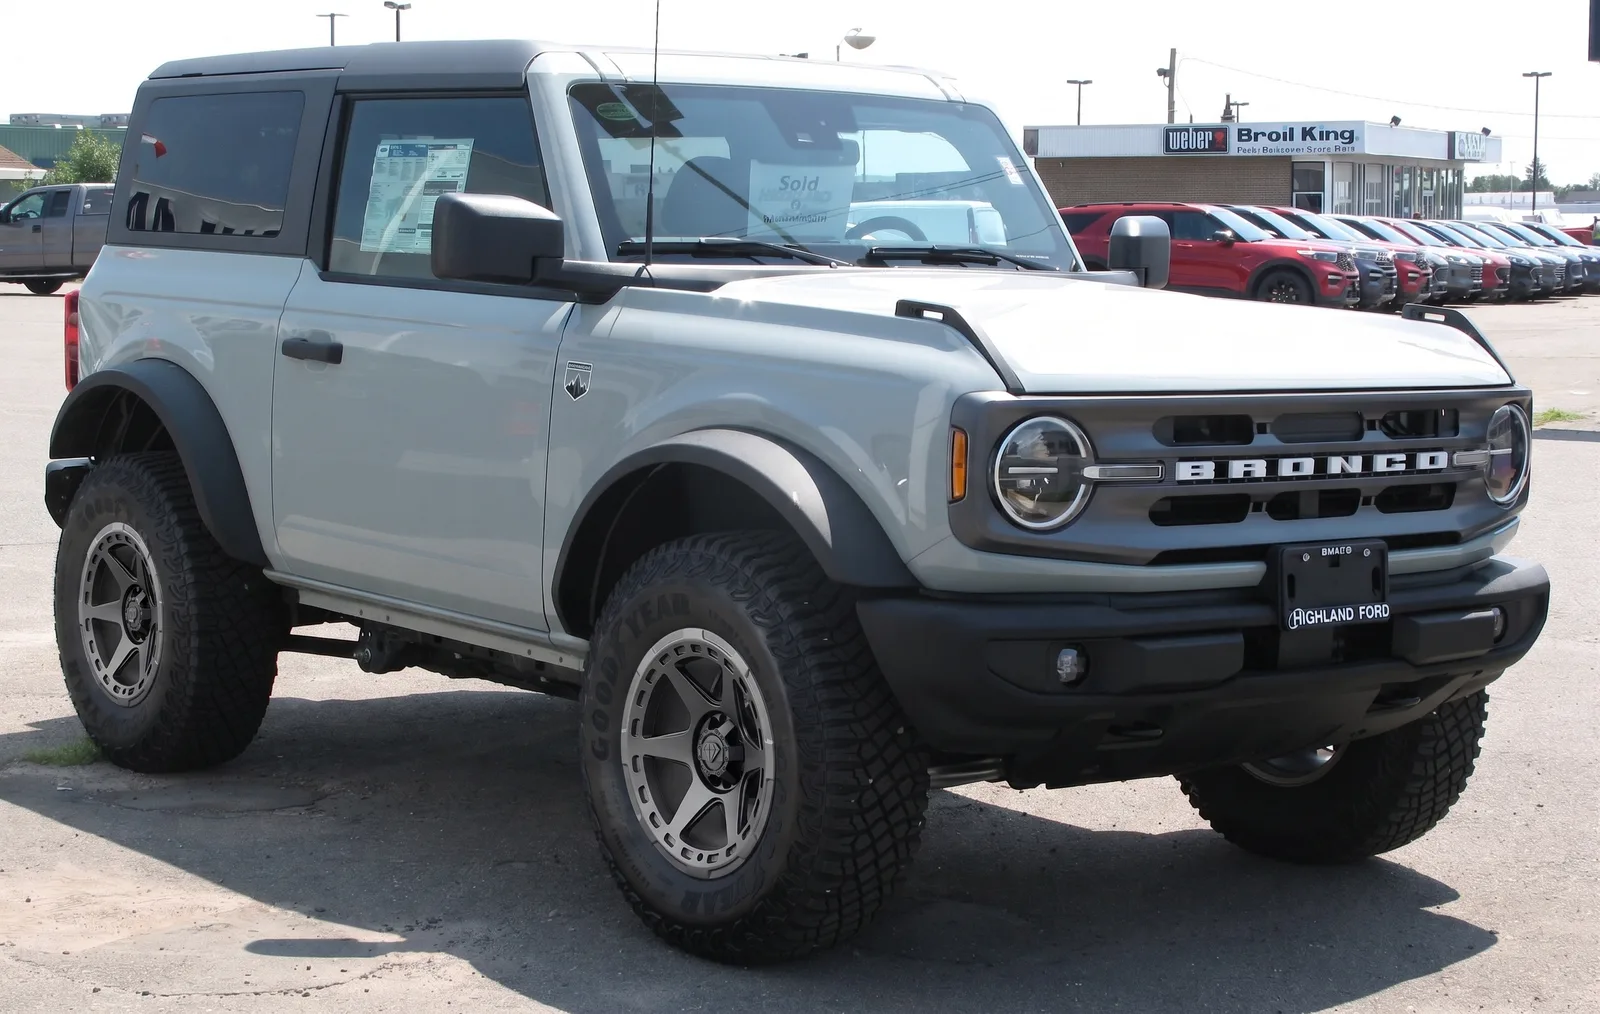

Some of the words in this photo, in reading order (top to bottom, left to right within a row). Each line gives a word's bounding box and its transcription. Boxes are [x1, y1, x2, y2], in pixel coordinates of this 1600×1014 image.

[1168, 127, 1213, 150] weber
[1237, 125, 1294, 142] Broil
[1301, 124, 1355, 144] King
[779, 175, 820, 191] Sold
[1175, 451, 1448, 481] BRONCO
[1288, 606, 1354, 629] HIGHLAND
[1359, 604, 1390, 620] FORD
